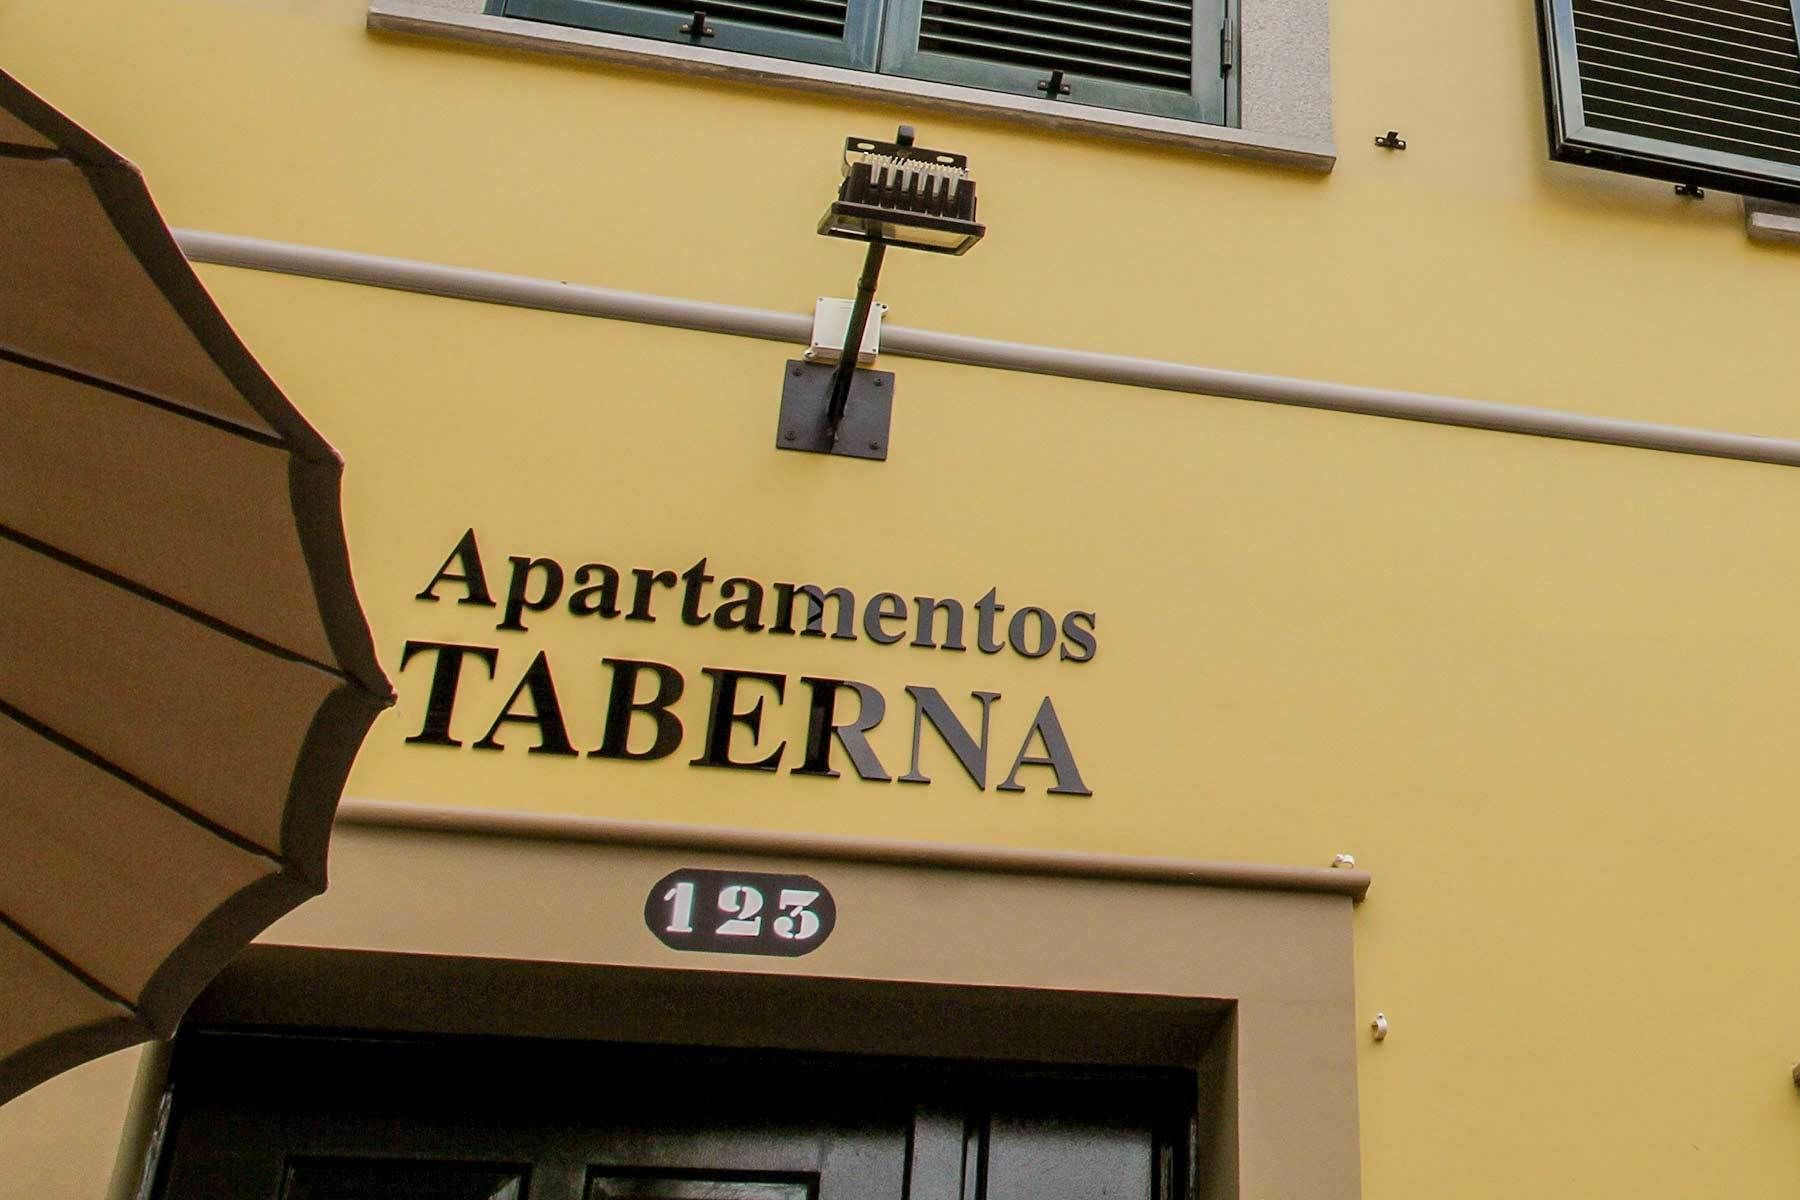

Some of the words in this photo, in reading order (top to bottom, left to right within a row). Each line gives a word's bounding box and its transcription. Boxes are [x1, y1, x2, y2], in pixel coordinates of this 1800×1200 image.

[415, 527, 1098, 663] Apartamentos
[400, 639, 1094, 797] TABERNA
[664, 881, 821, 941] 123
